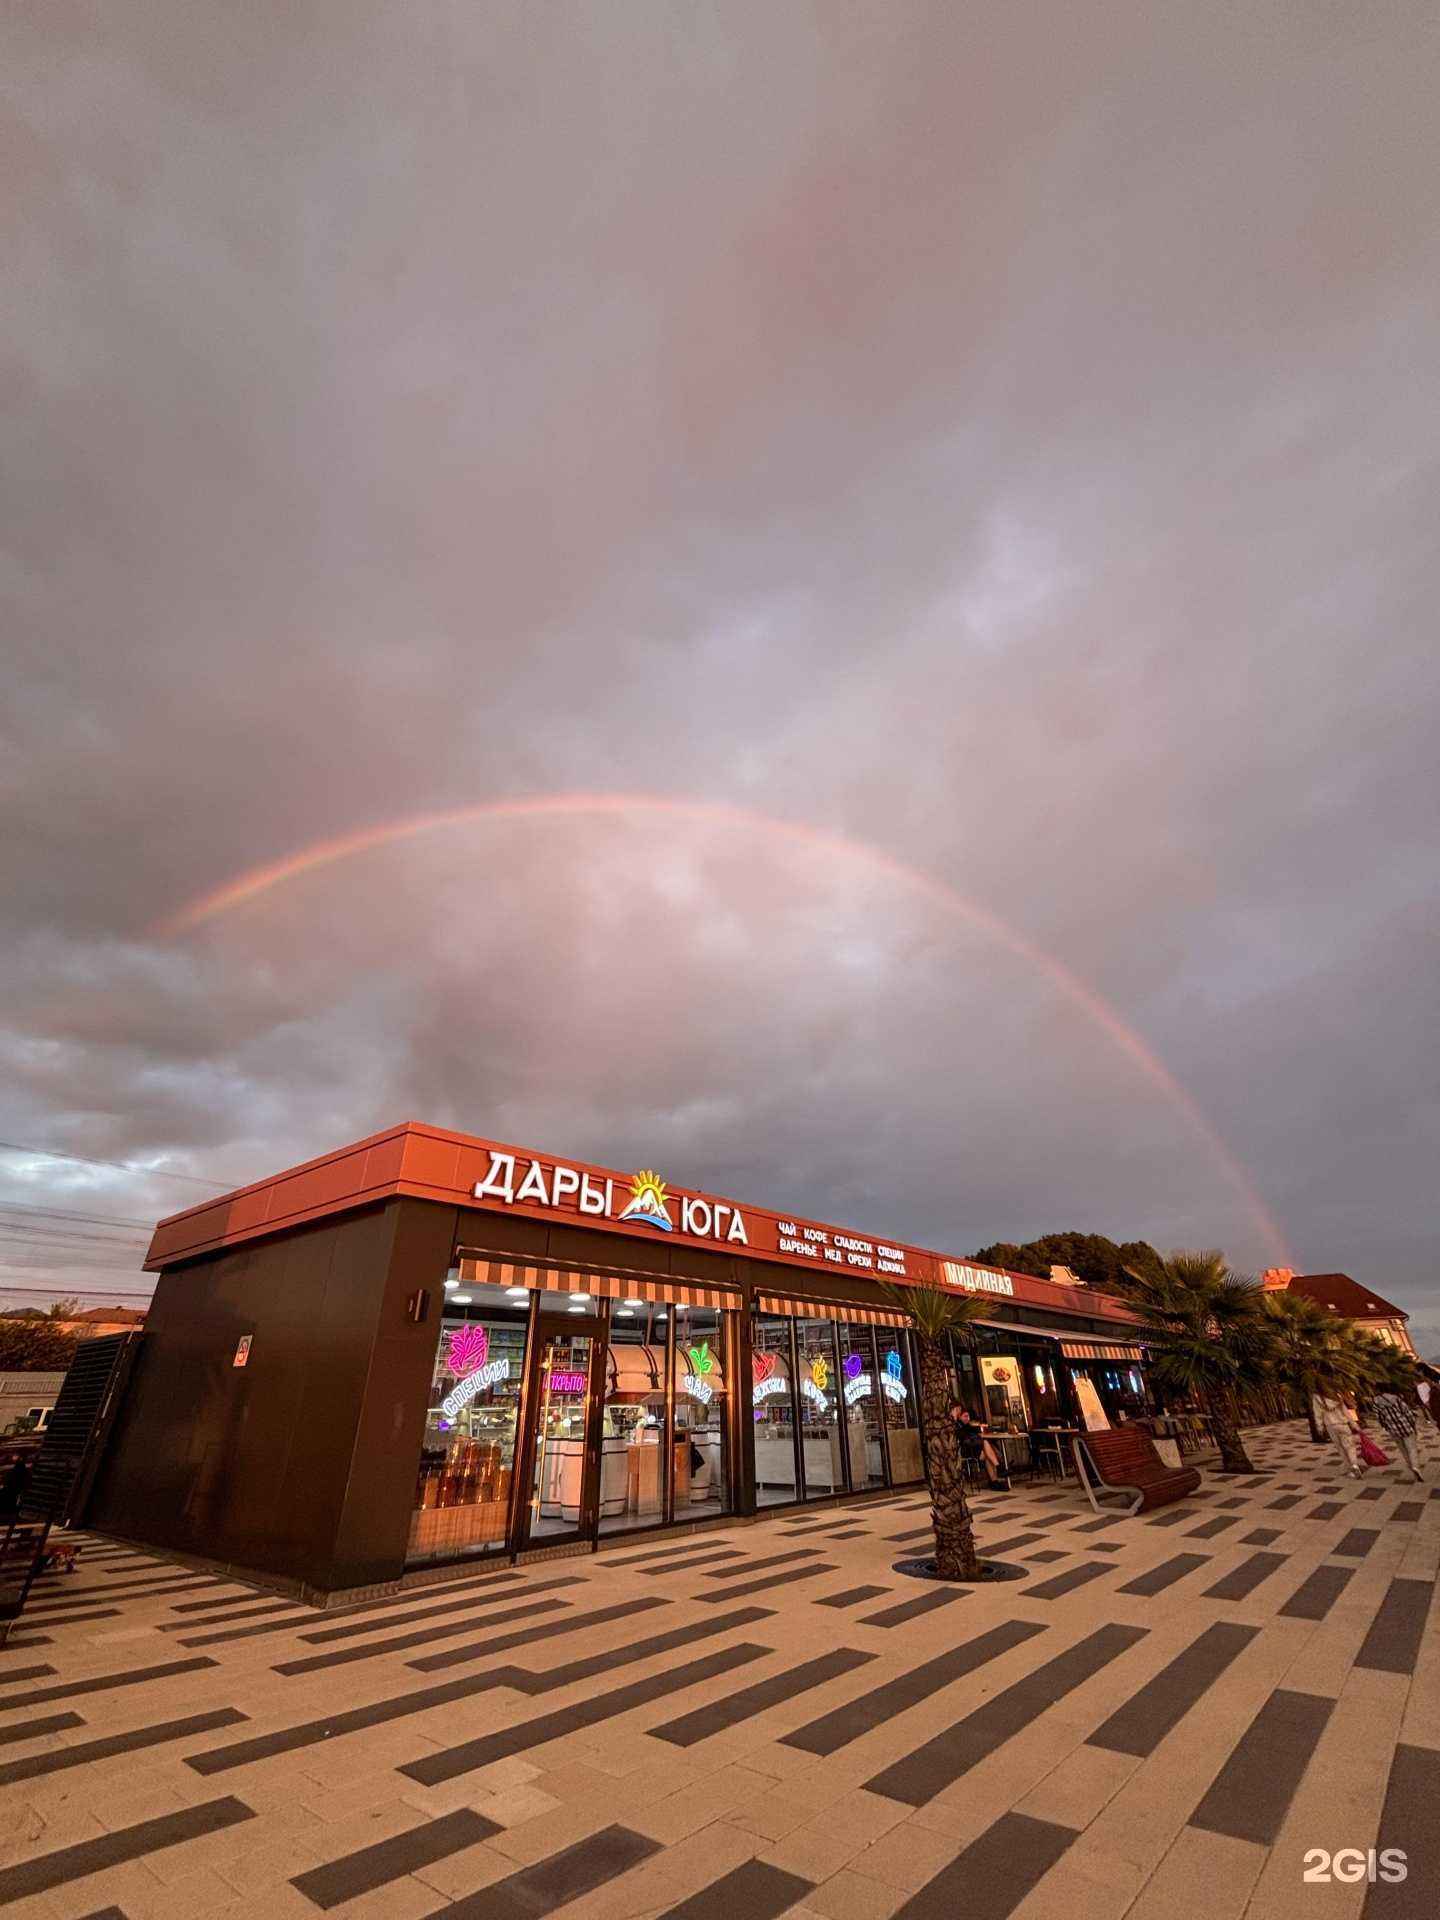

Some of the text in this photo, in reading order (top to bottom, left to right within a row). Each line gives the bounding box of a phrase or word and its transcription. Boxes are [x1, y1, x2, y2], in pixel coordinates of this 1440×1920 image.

[474, 1151, 749, 1245] ДАРЫ ЮГА
[778, 1221, 905, 1261] ЧАЙ КОФЕ СЛАДОСТИ СПЕЦИИ
[779, 1238, 906, 1275] ВАРЕНЬЕ МЕД ОРЕХИ АДЖИКА
[442, 1358, 511, 1417] СПЕЦИИ
